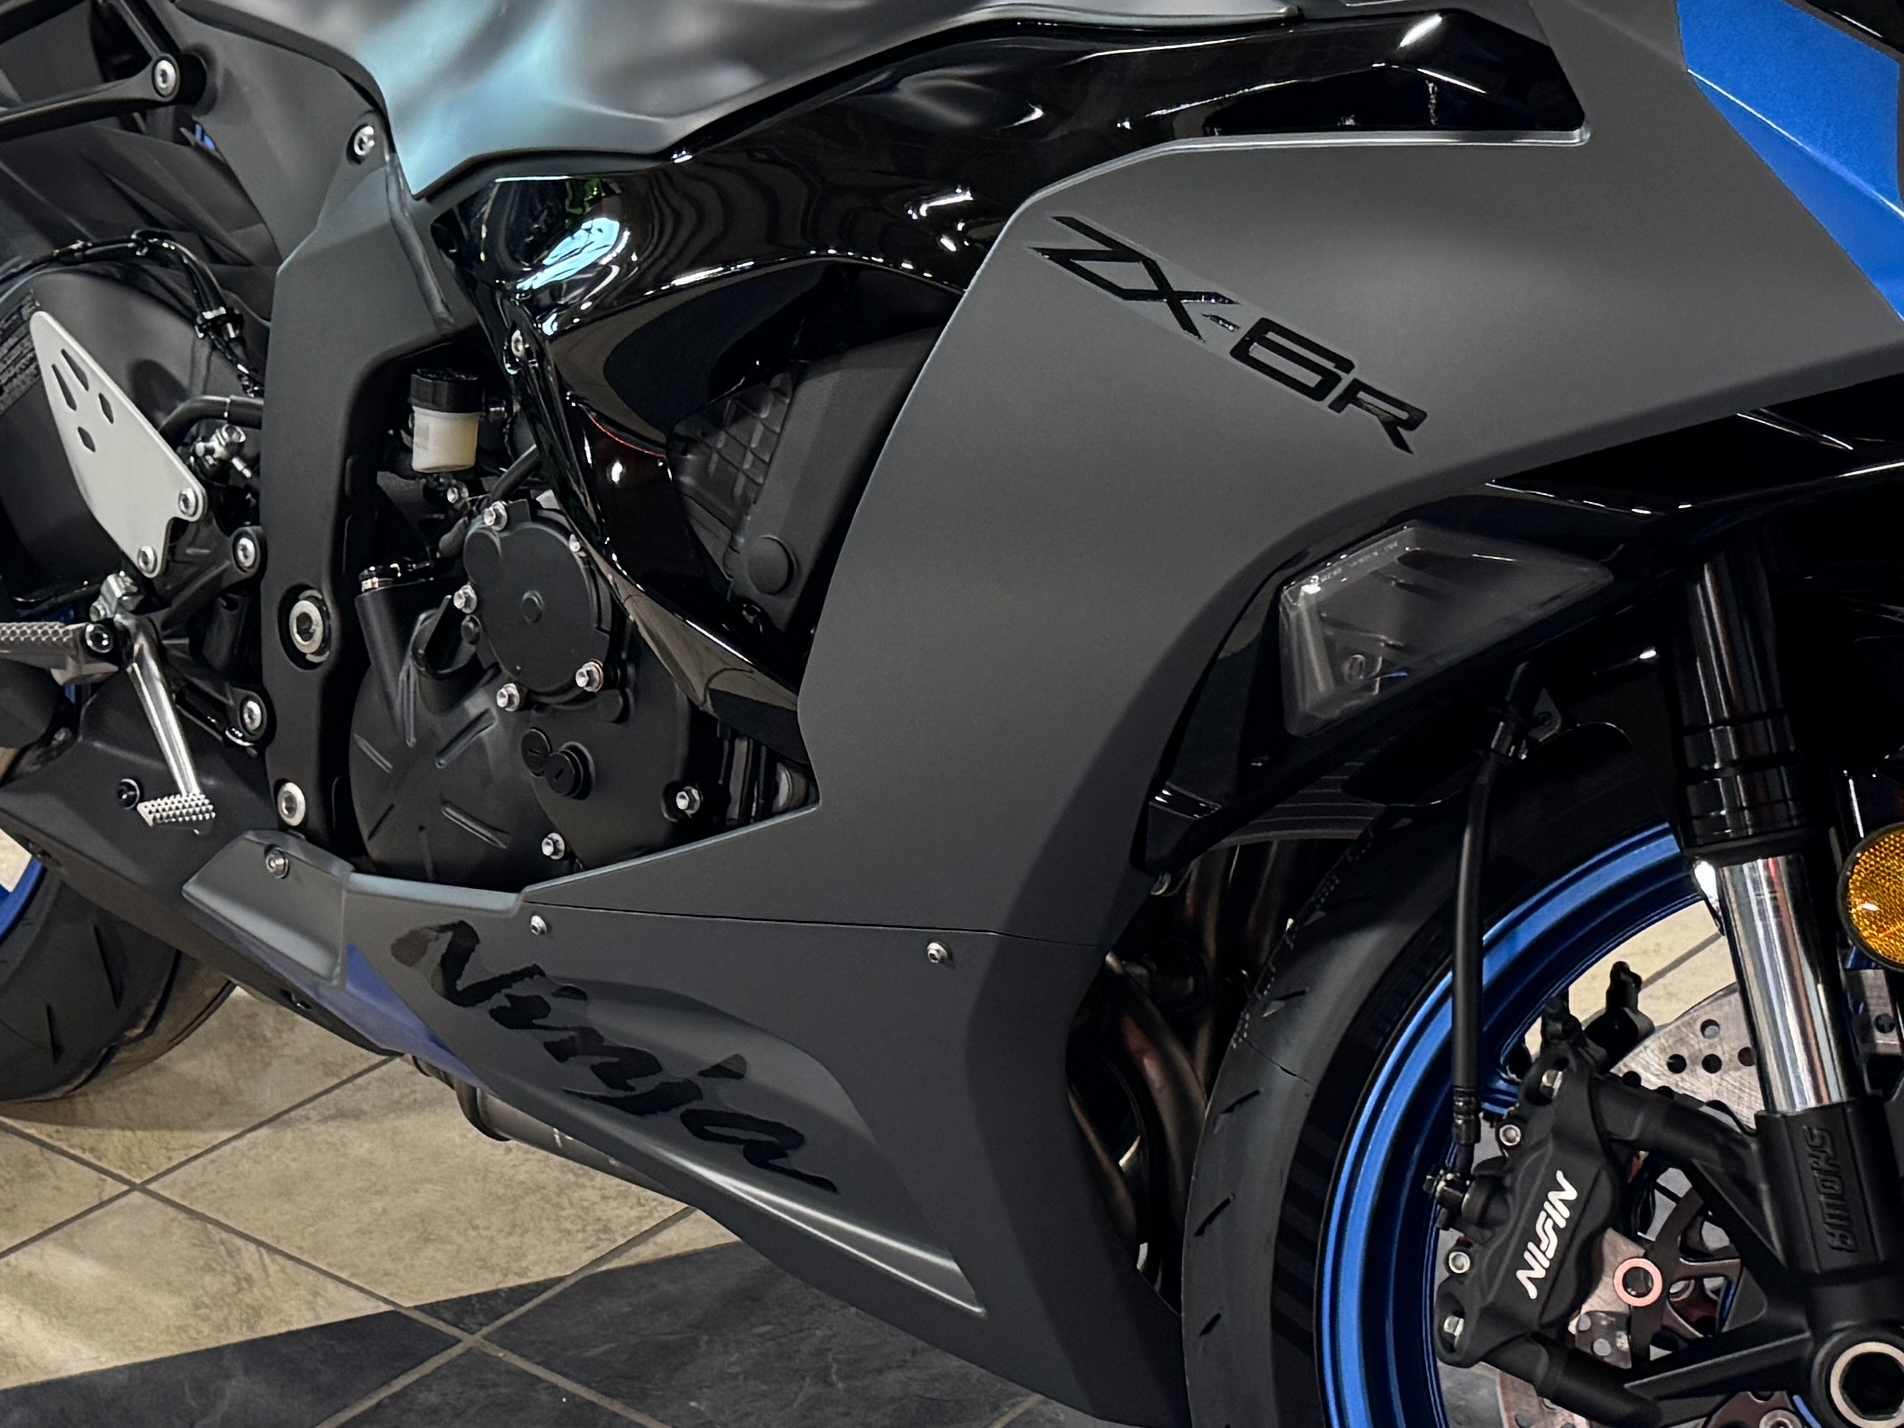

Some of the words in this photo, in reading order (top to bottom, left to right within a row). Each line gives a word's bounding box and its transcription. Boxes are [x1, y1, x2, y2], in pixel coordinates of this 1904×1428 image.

[1027, 215, 1429, 455] ZX-6R
[391, 918, 839, 1194] Ninja
[1515, 1170, 1578, 1299] NISSIN
